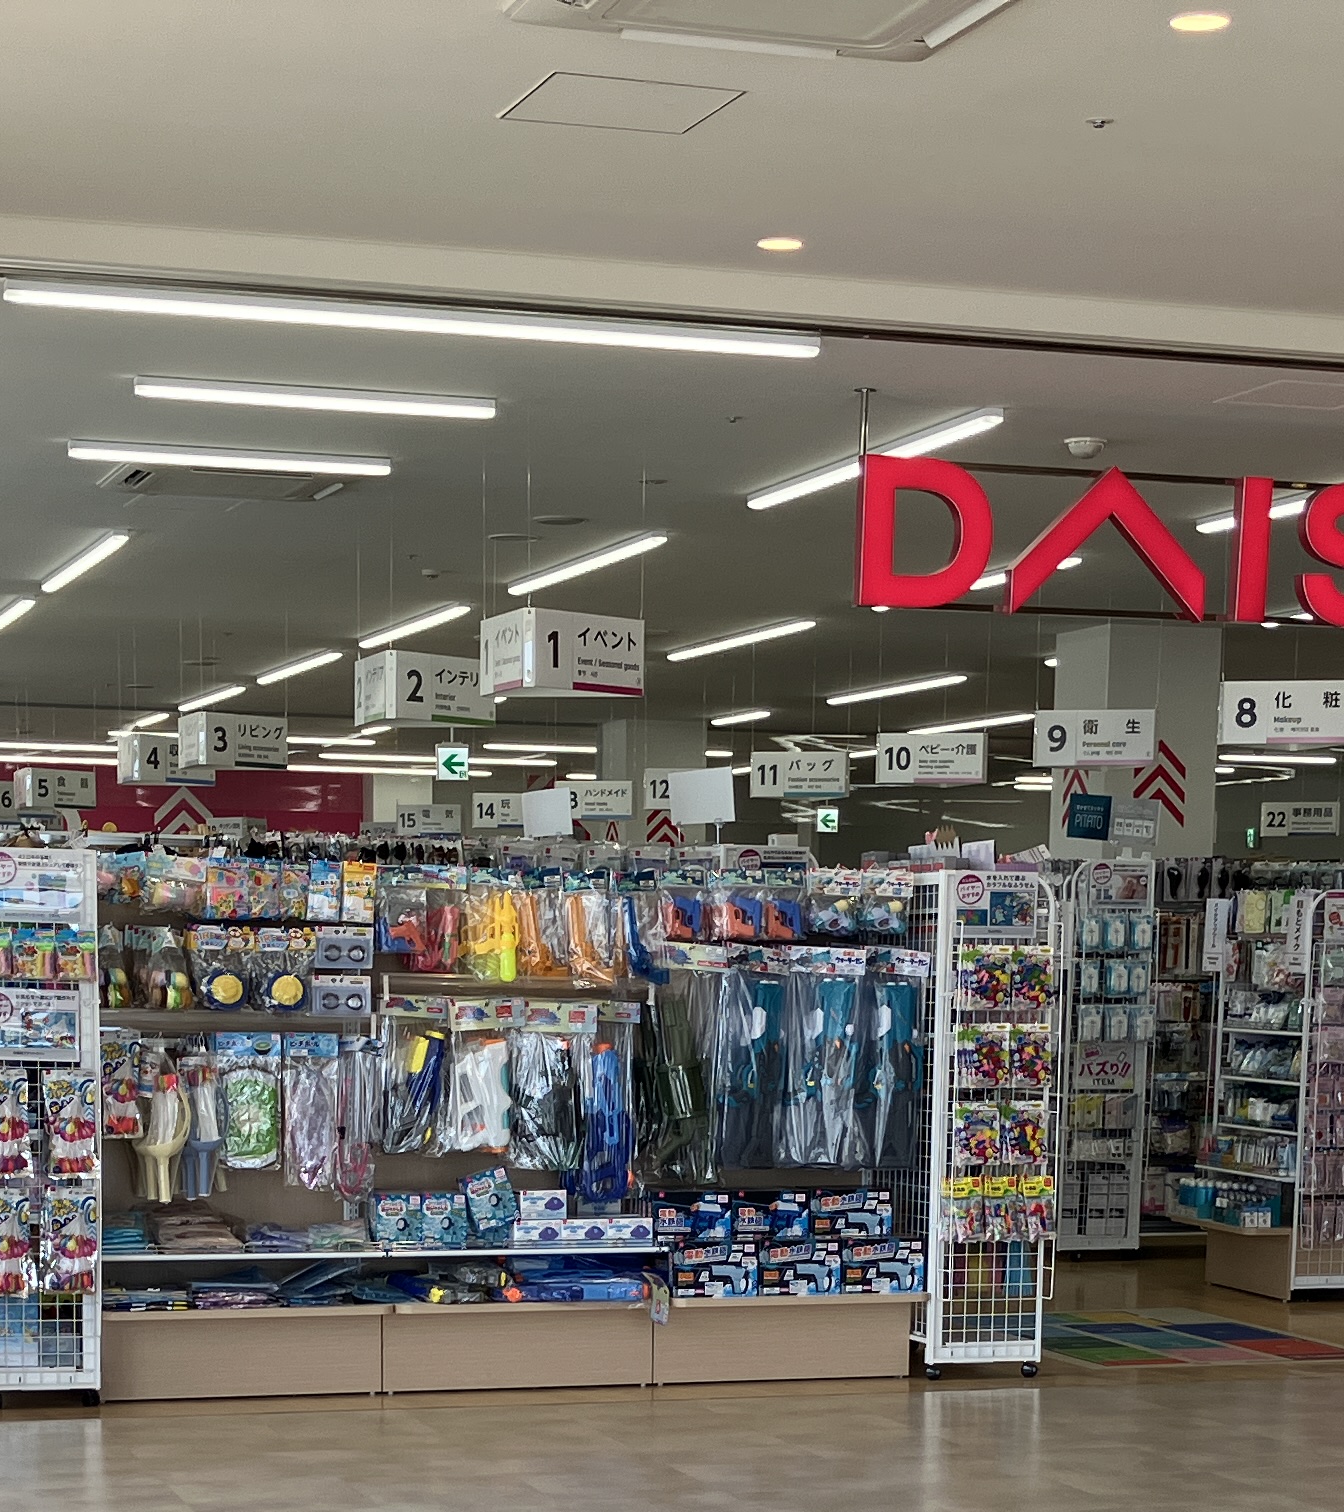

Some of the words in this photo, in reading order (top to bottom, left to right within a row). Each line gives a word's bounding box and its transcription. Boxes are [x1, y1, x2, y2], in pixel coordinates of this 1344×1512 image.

[547, 630, 559, 669] 1
[577, 627, 637, 652] イベント
[406, 669, 424, 703] 2
[434, 668, 479, 688] インテリ
[1274, 690, 1341, 709] 化粧
[1235, 697, 1257, 729] 8
[1273, 716, 1302, 725] Makeup
[237, 723, 284, 741] リビング
[1082, 718, 1142, 735] 衛生
[213, 726, 228, 753] 3
[1047, 724, 1067, 753] 9
[146, 746, 160, 770] 4
[788, 759, 835, 772] バッグ
[884, 746, 911, 771] 10
[757, 764, 778, 786] 11
[37, 778, 49, 798] 5
[584, 788, 627, 798] ハンドメイド
[649, 779, 670, 799] 12
[1, 790, 12, 809] 6
[476, 802, 496, 819] 14
[1266, 811, 1287, 828] 22
[399, 813, 416, 829] 15
[1092, 1078, 1116, 1086] ITEM
